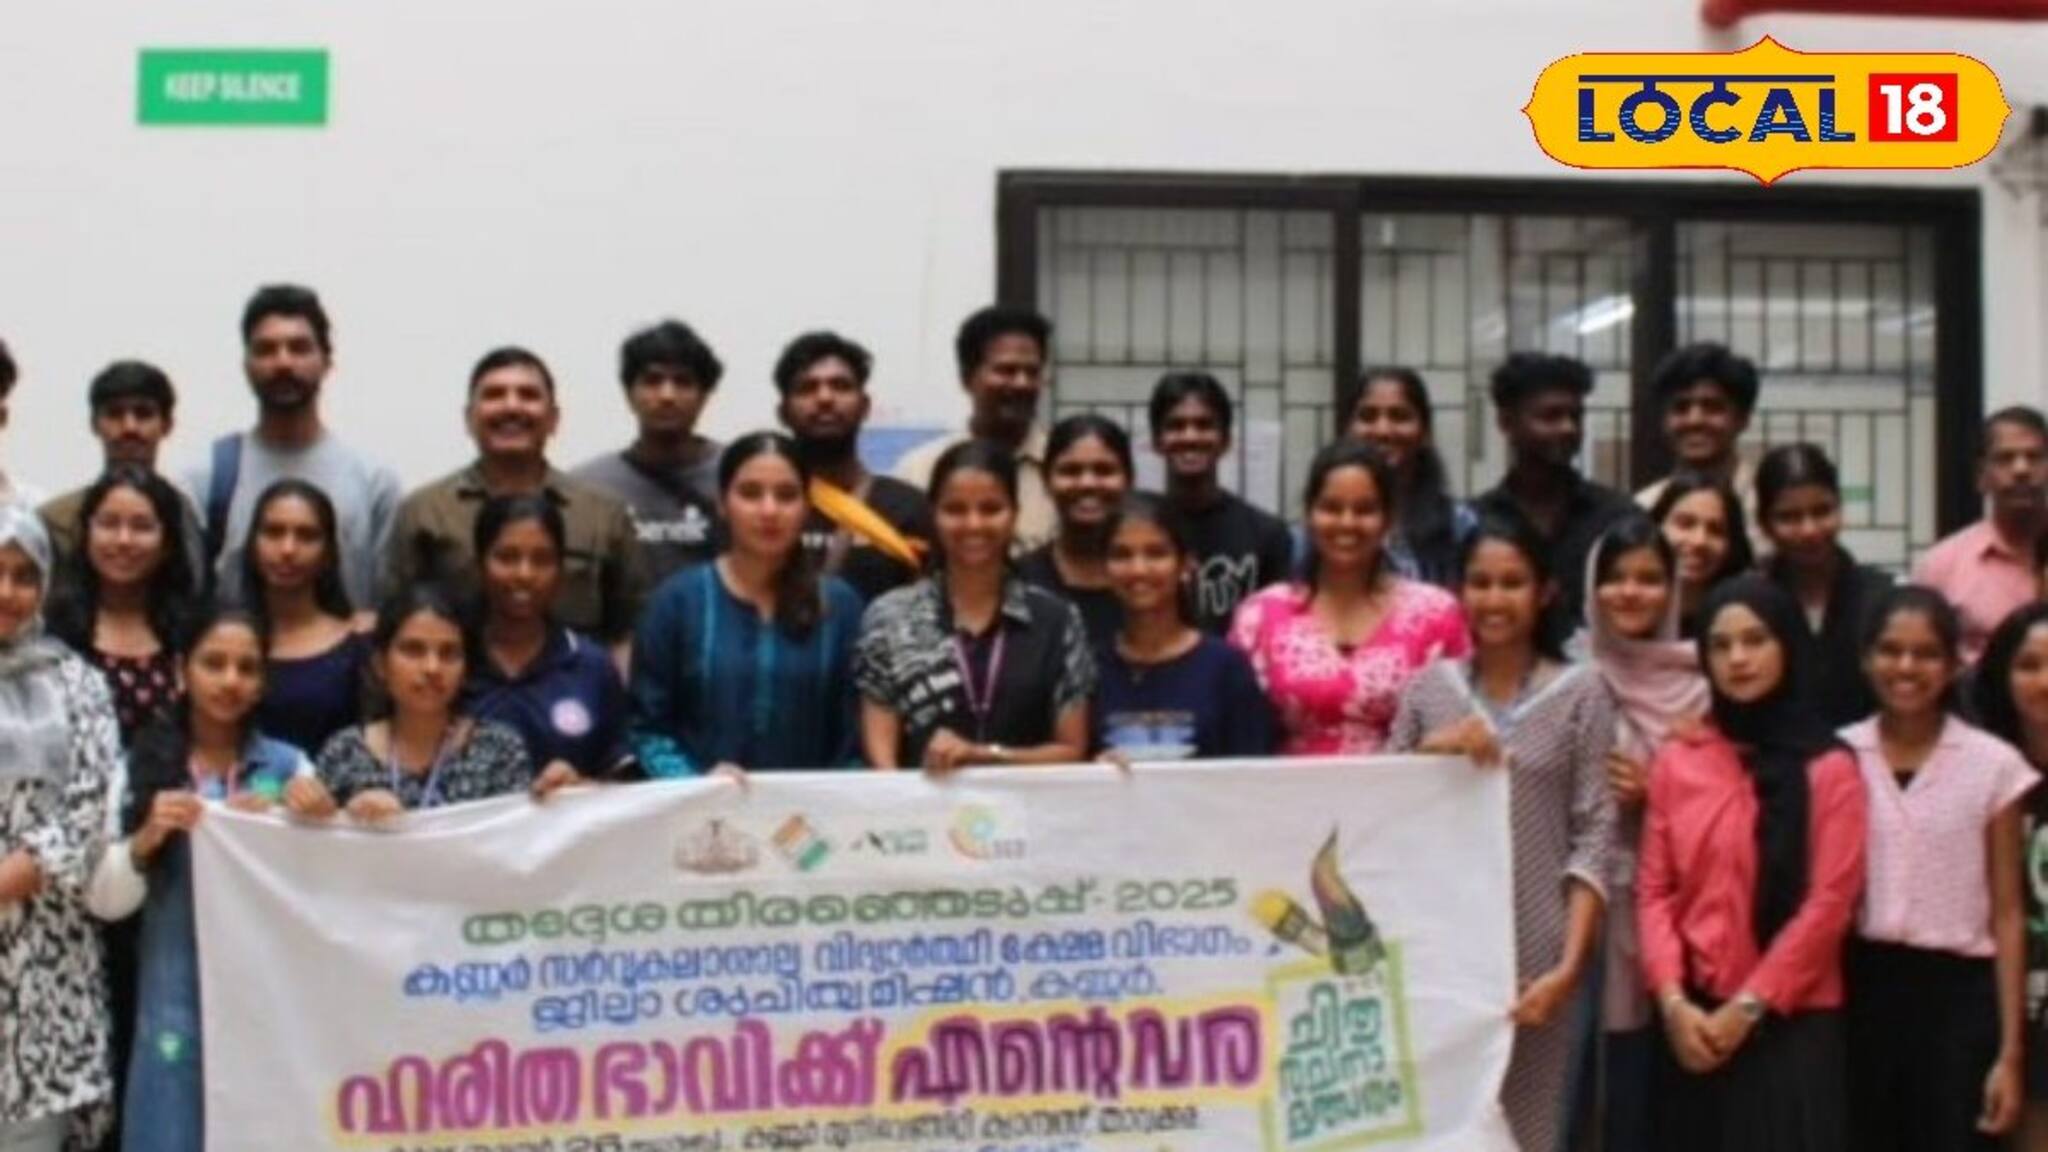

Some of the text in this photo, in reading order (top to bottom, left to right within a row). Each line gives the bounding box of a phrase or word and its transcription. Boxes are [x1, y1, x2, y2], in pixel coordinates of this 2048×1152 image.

[165, 72, 215, 101] KEEP
[1114, 878, 1237, 912] 2025
[338, 1038, 583, 1136] ഹരിത
